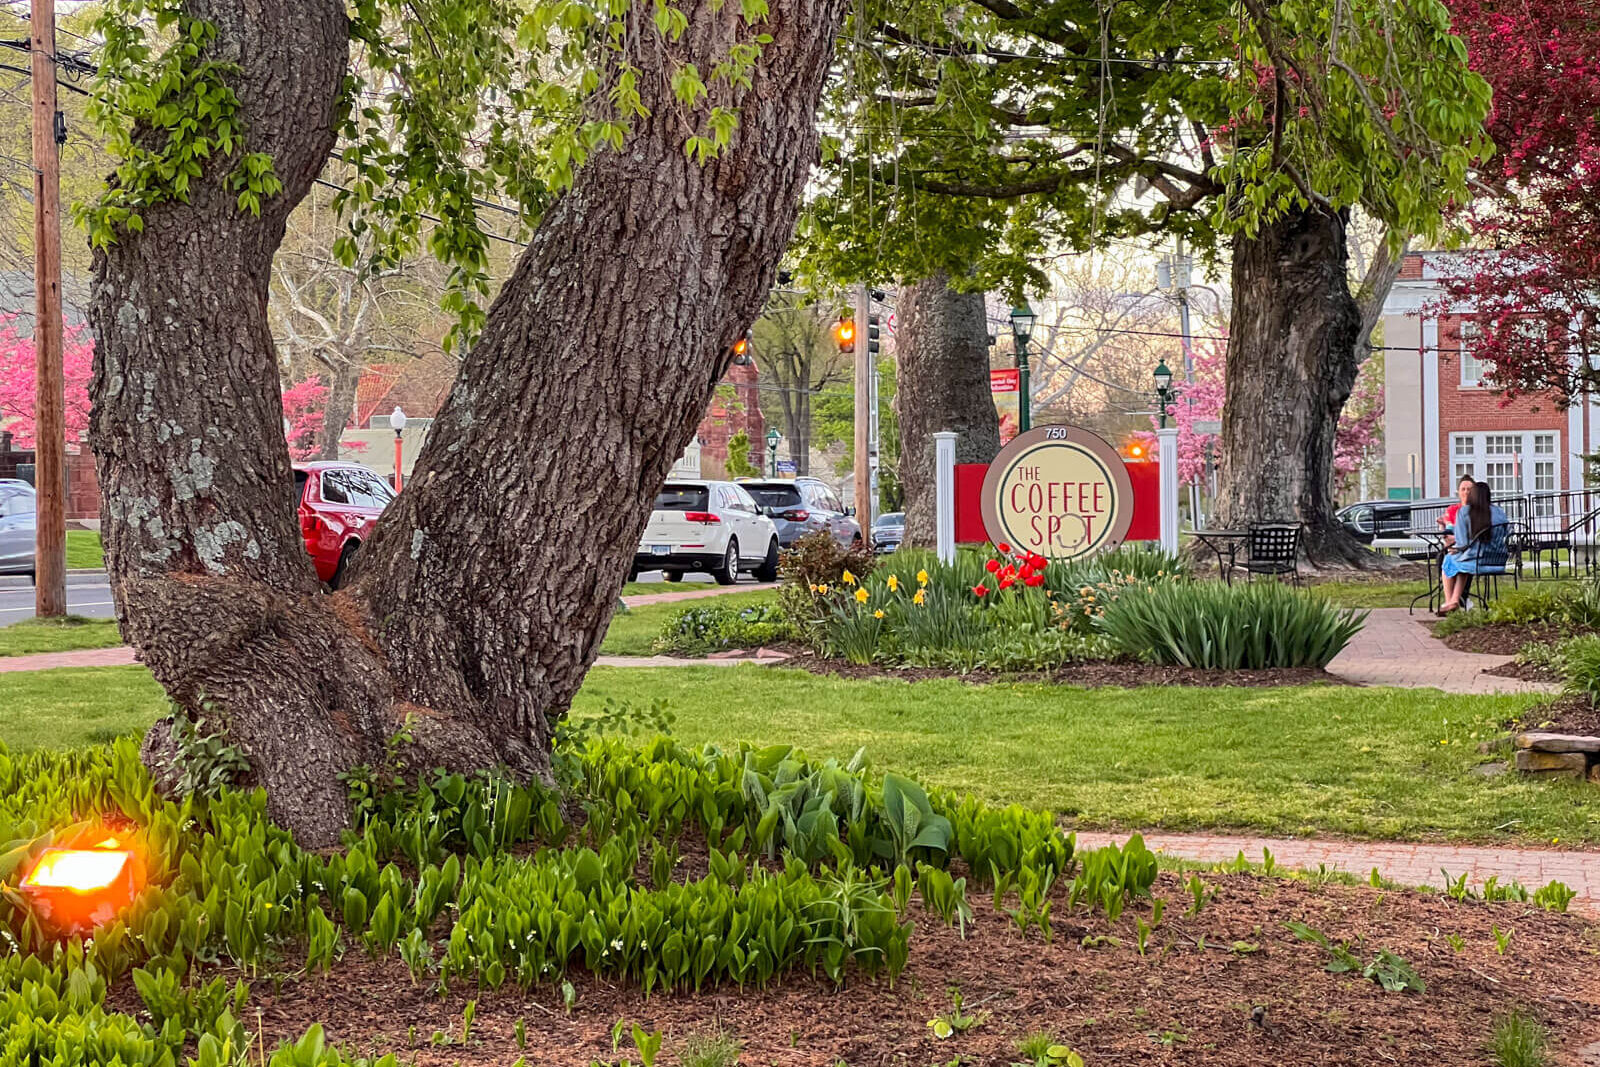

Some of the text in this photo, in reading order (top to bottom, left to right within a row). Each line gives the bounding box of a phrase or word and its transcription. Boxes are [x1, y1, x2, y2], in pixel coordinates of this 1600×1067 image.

[1045, 428, 1067, 439] 750
[1017, 467, 1041, 481] THE
[1011, 482, 1105, 513] COFFEE
[1030, 514, 1096, 547] SPOT
